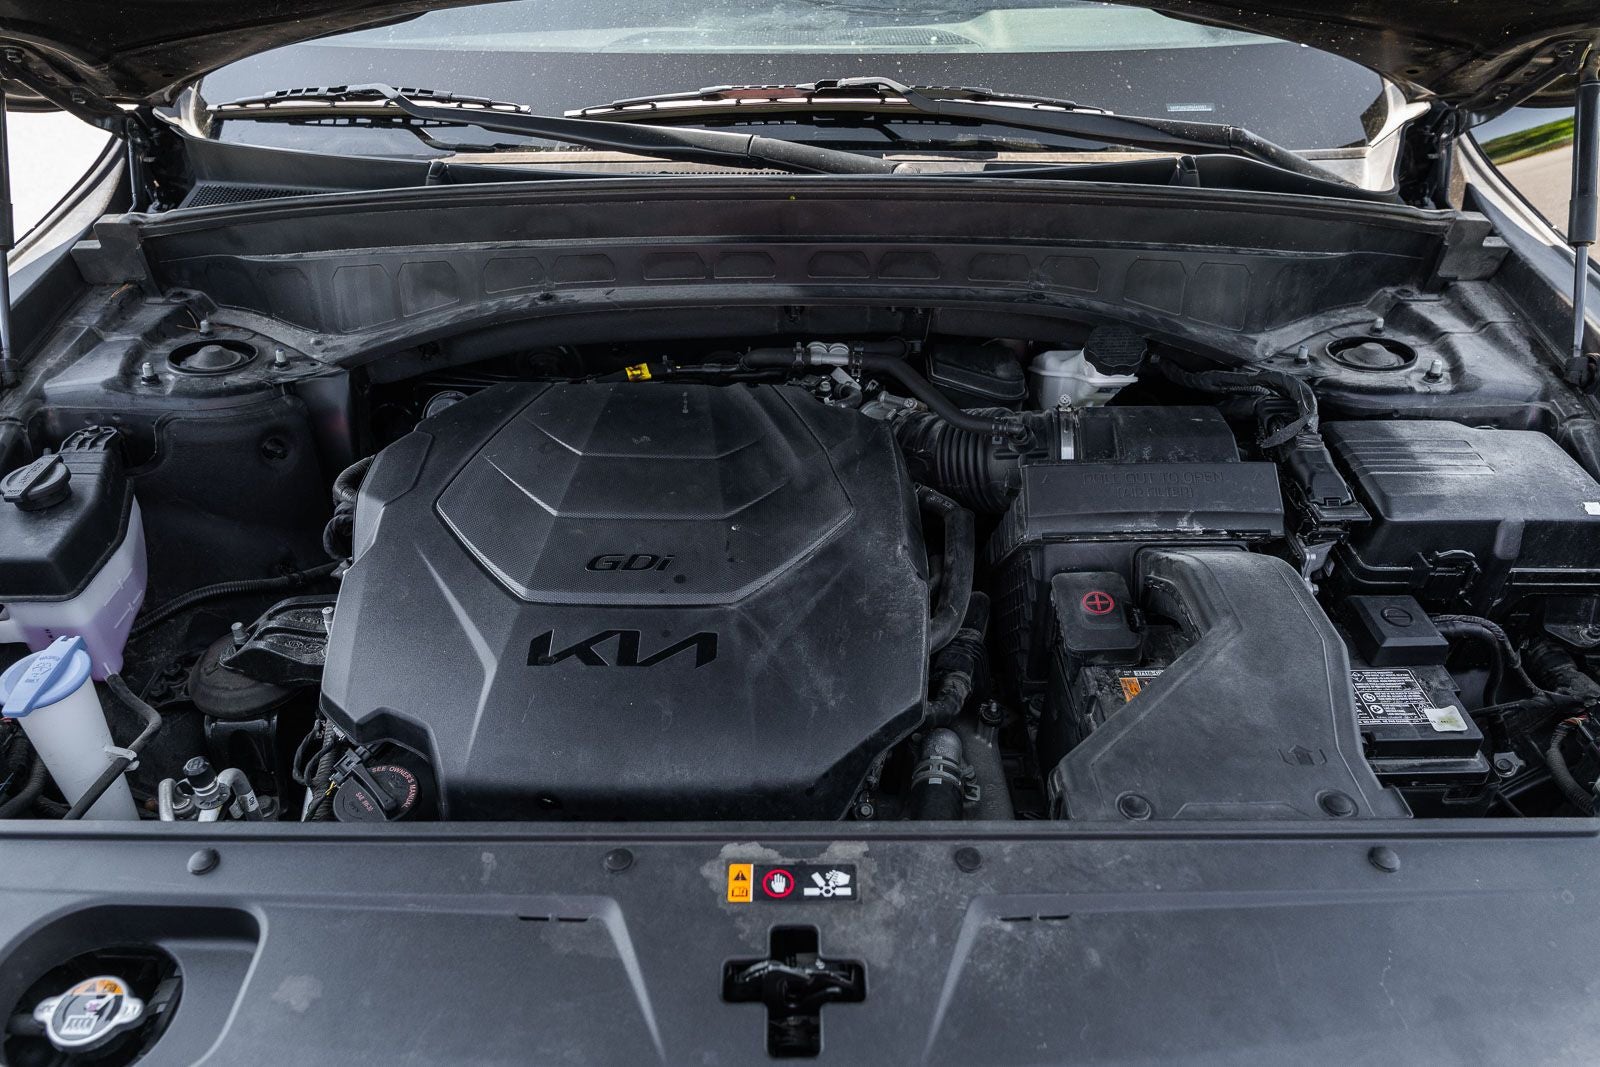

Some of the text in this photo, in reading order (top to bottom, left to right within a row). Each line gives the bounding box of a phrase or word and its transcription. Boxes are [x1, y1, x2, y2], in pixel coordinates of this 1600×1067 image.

[1126, 471, 1155, 484] OUT
[1160, 471, 1180, 484] TO
[1183, 470, 1225, 483] OPEN
[585, 553, 675, 573] GDi
[526, 628, 719, 669] KIA
[389, 766, 415, 784] OWNER'S
[400, 784, 417, 809] MANUAL
